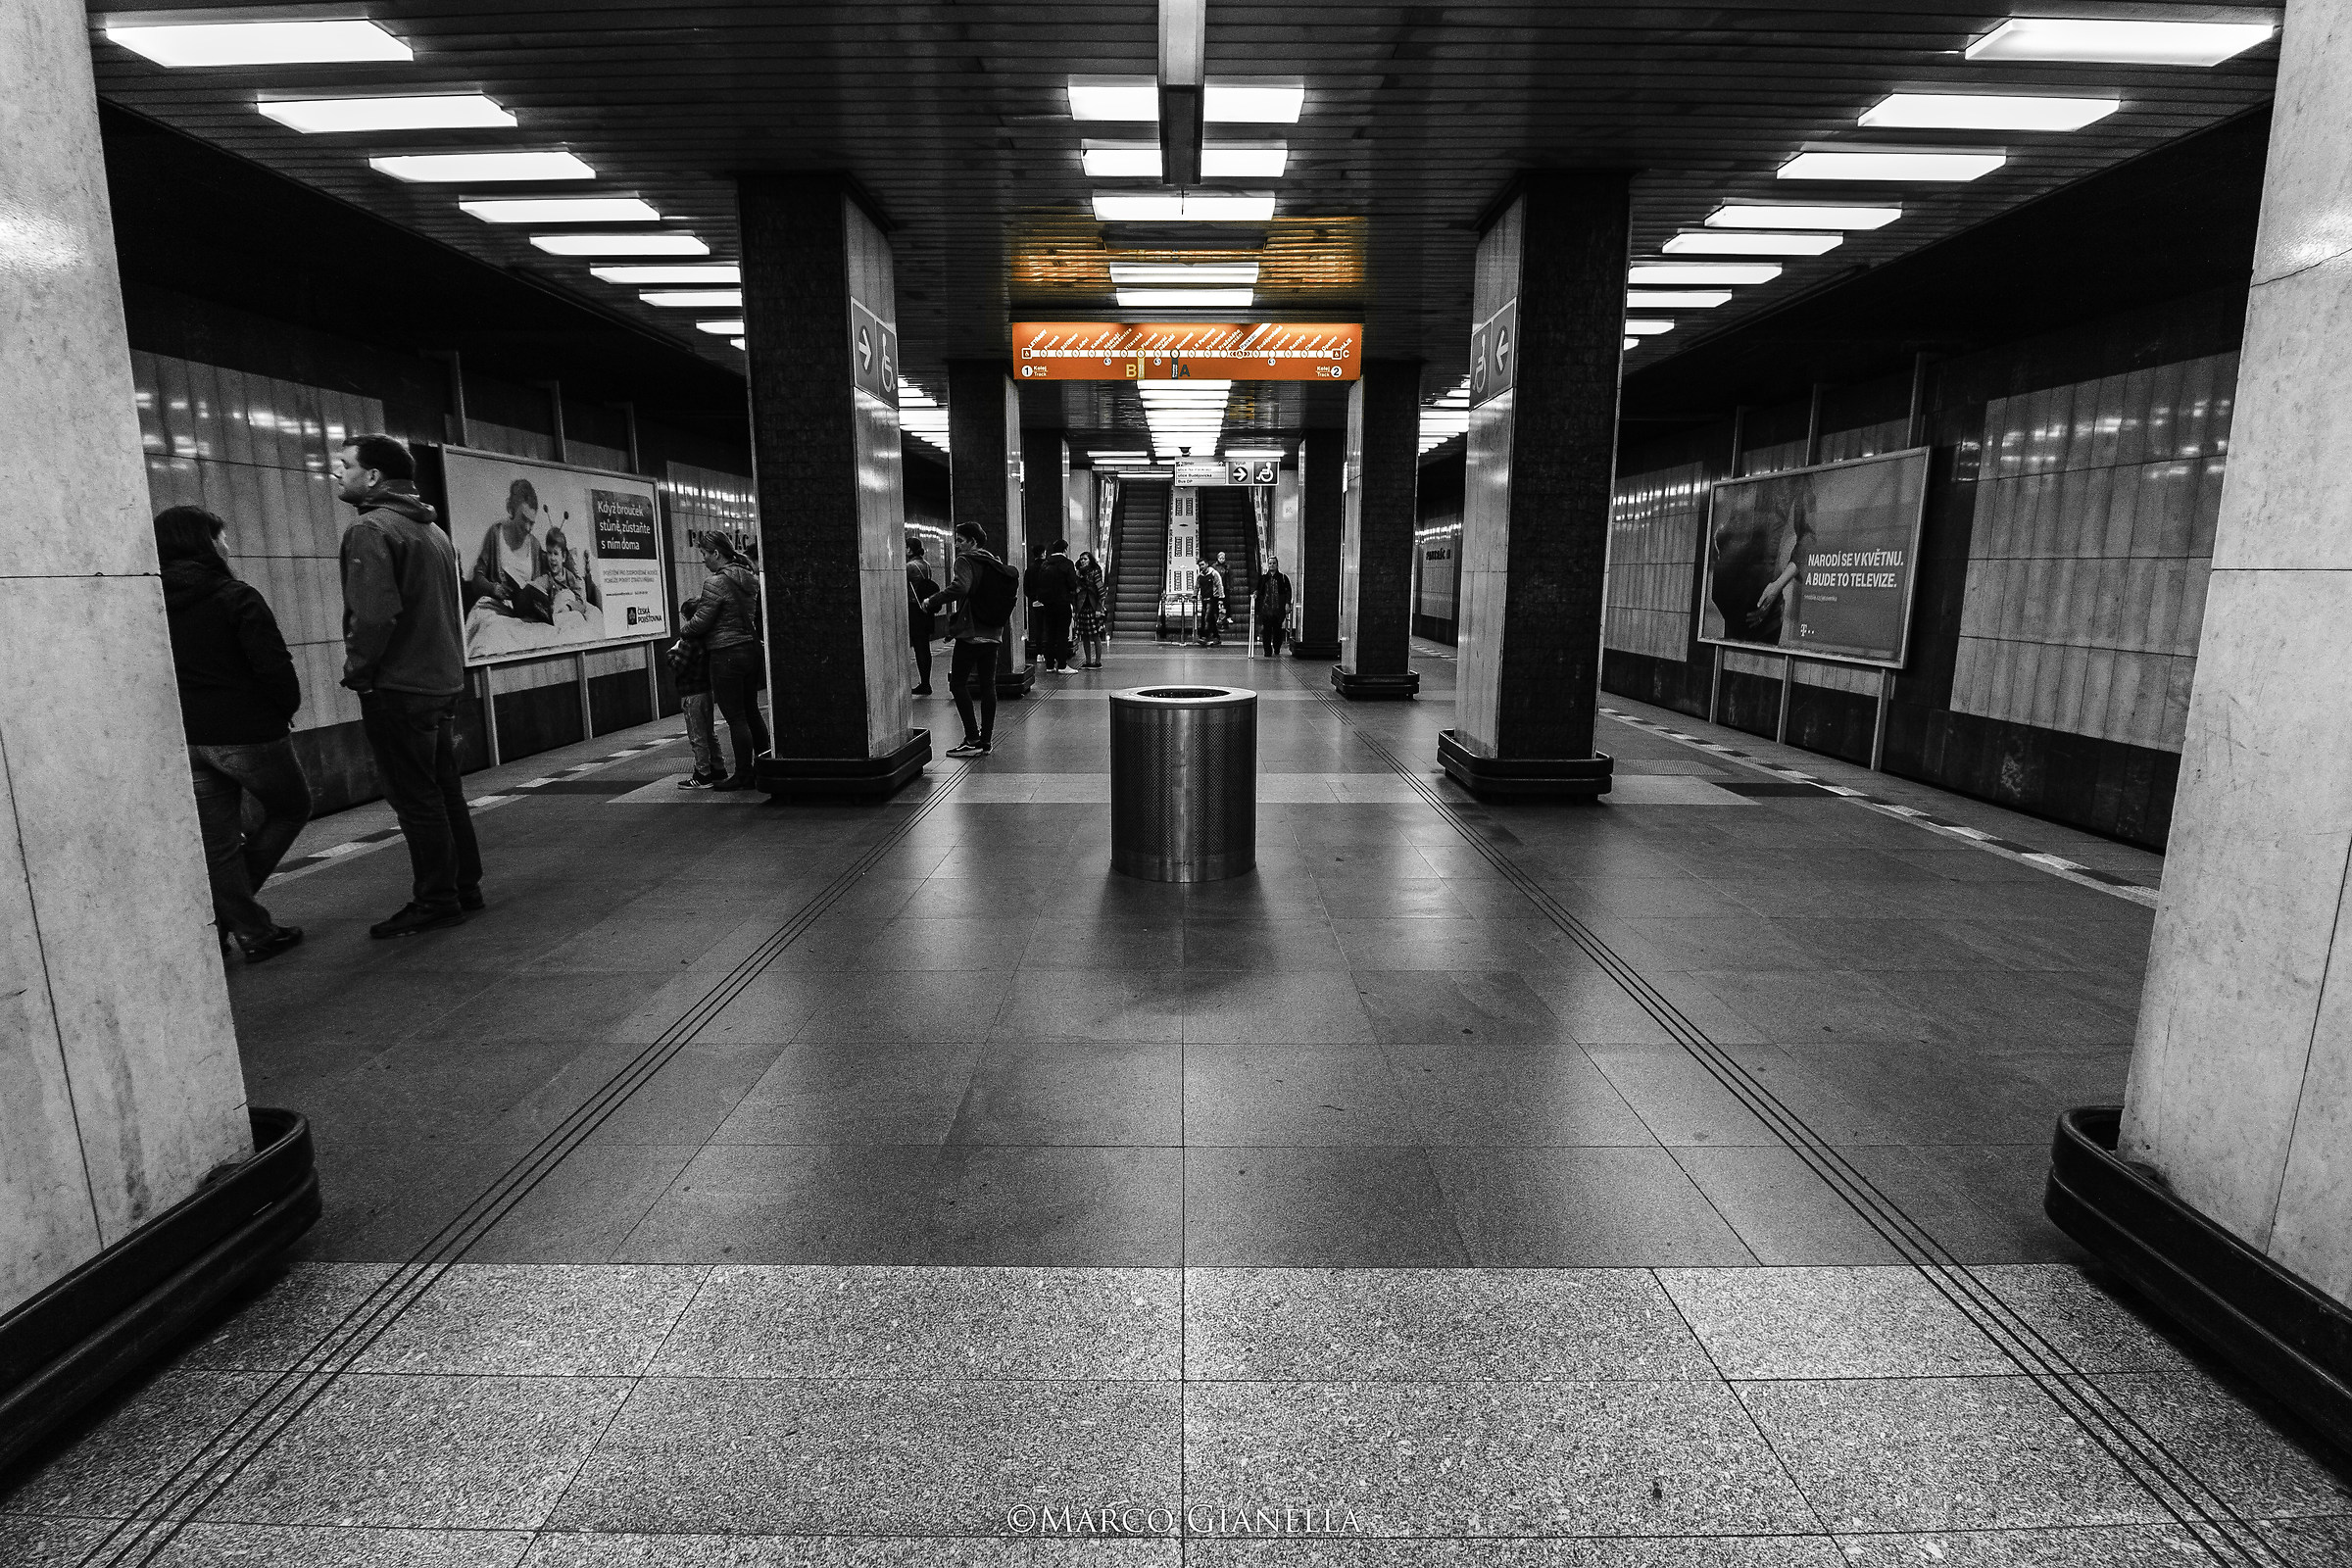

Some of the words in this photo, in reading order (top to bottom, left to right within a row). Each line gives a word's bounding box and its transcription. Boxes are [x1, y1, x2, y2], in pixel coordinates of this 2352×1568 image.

[1343, 349, 1349, 358] C
[1126, 364, 1137, 377] B
[1180, 364, 1191, 377] A
[1333, 367, 1340, 376] 2
[598, 501, 616, 516] Když
[622, 520, 651, 534] zůstaňte
[601, 540, 606, 549] s
[608, 537, 620, 549] ním
[621, 537, 640, 550] doma
[1808, 551, 1841, 566] NARODÍ
[1841, 553, 1853, 566] SE
[1854, 552, 1861, 565] V
[1861, 549, 1904, 566] KVĚTNU.
[1805, 572, 1812, 585] A
[1812, 572, 1836, 586] BUDE
[1838, 572, 1849, 586] TO
[1850, 572, 1897, 587] TELEVIZE.
